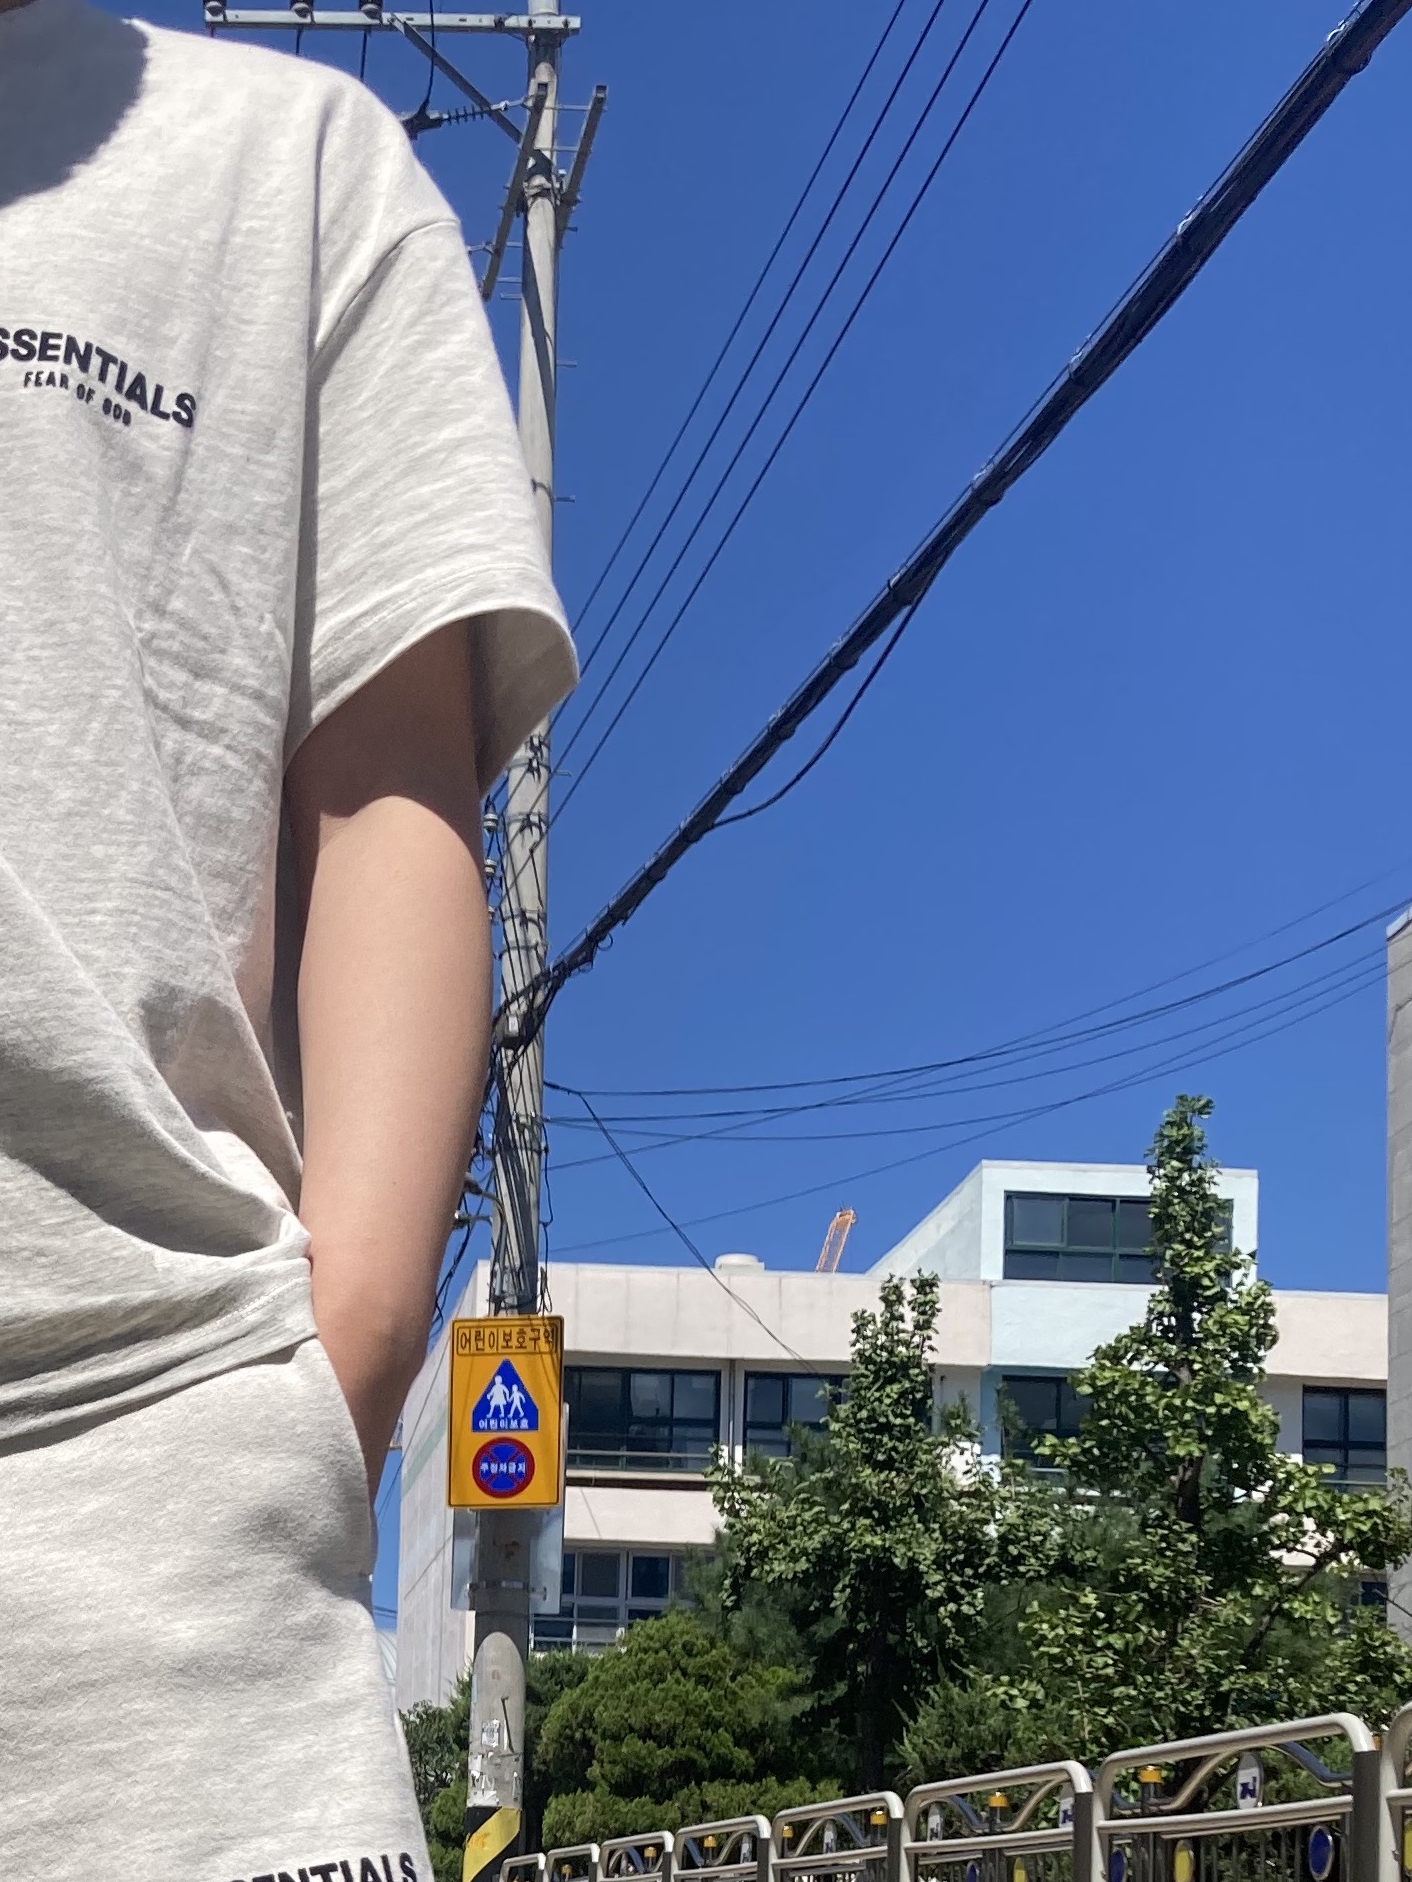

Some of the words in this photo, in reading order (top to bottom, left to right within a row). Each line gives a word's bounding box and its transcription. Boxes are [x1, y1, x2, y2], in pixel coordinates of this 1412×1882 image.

[23, 370, 70, 390] FEAR
[76, 383, 95, 404] OF
[459, 1327, 557, 1352] 어린이보호구역
[478, 1418, 529, 1430] 어린이보호
